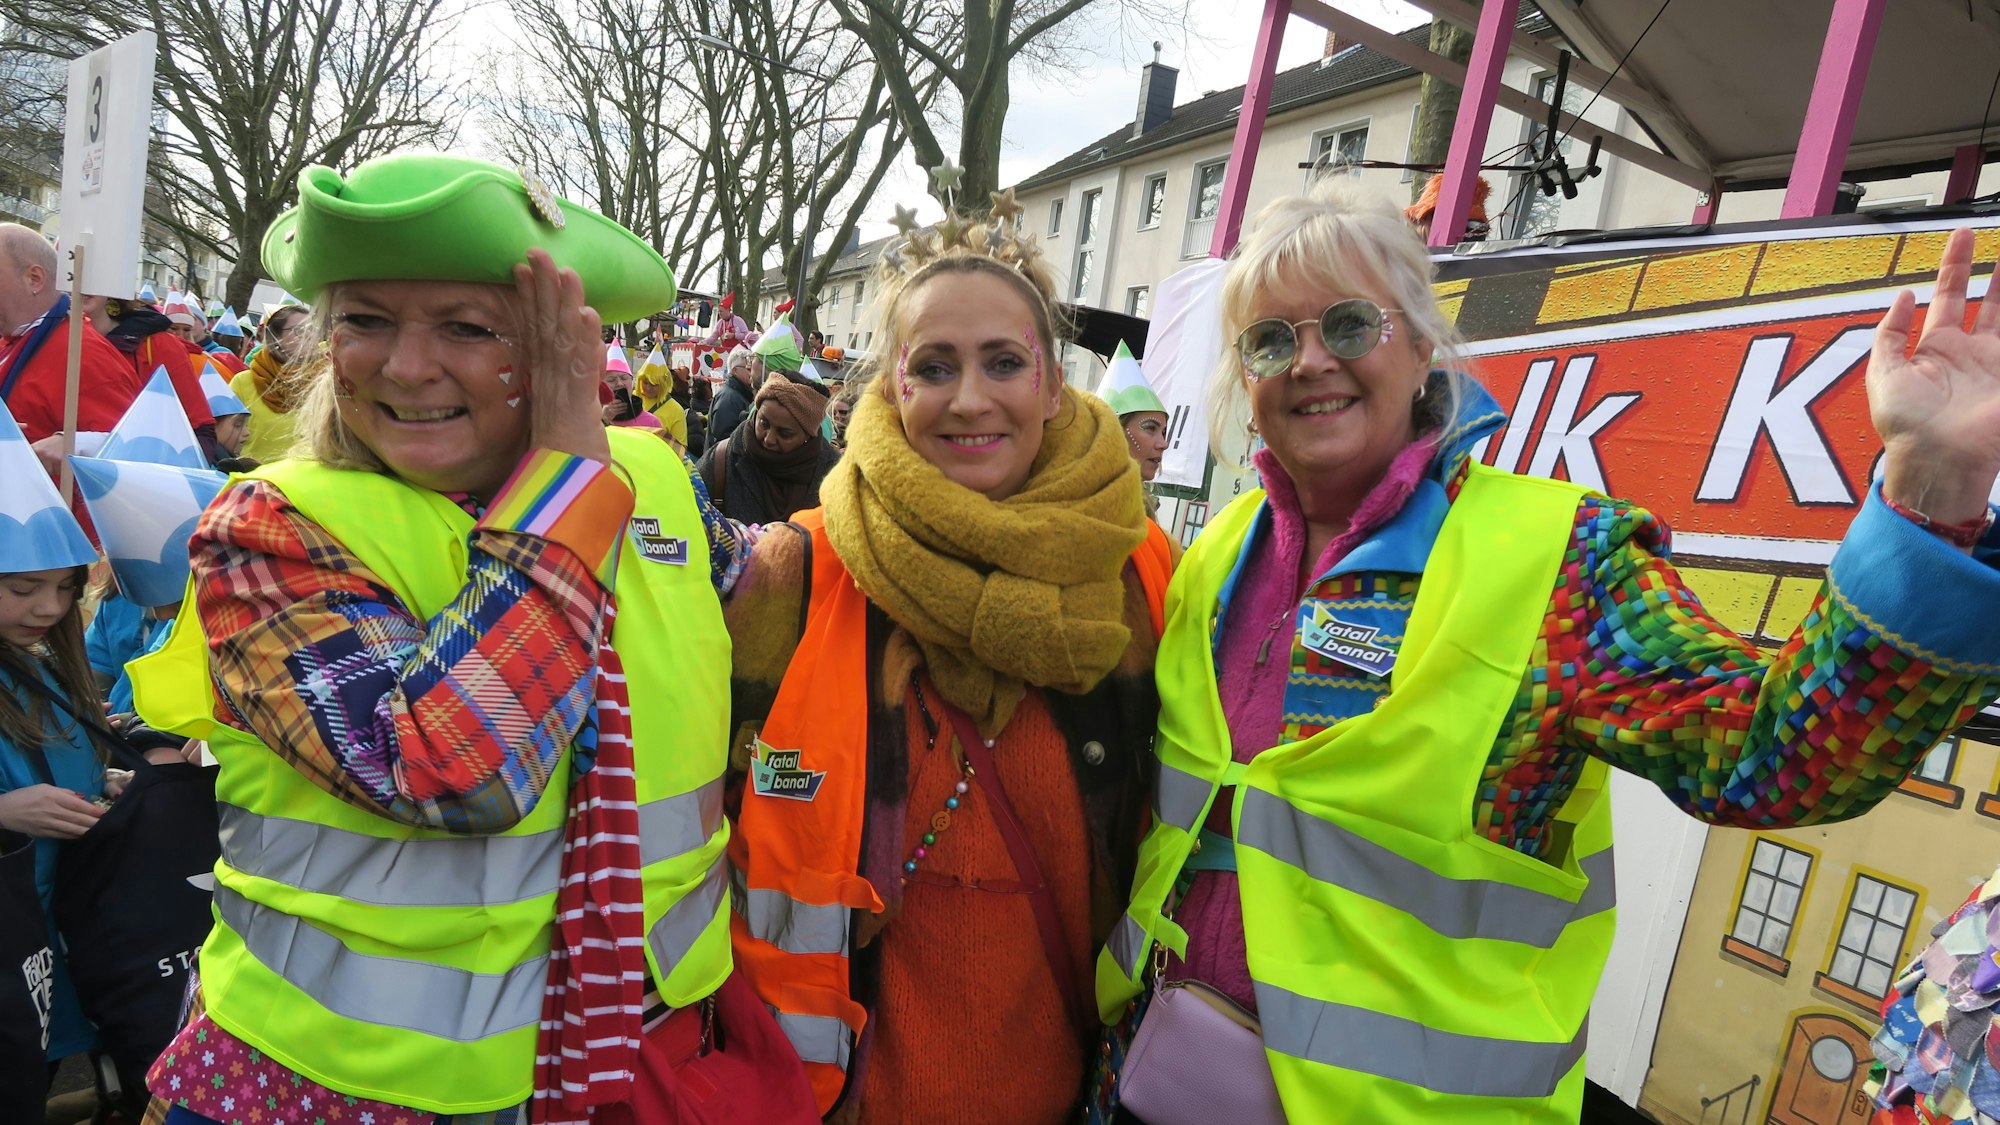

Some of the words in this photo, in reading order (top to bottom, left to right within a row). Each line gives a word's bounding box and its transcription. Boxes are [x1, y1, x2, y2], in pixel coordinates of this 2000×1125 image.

[90, 75, 102, 143] 3
[1470, 352, 1643, 497] lk
[643, 539, 679, 555] banal
[1322, 621, 1373, 642] fatal
[1322, 639, 1387, 664] banal
[768, 753, 798, 769] fatal
[773, 774, 811, 789] banal
